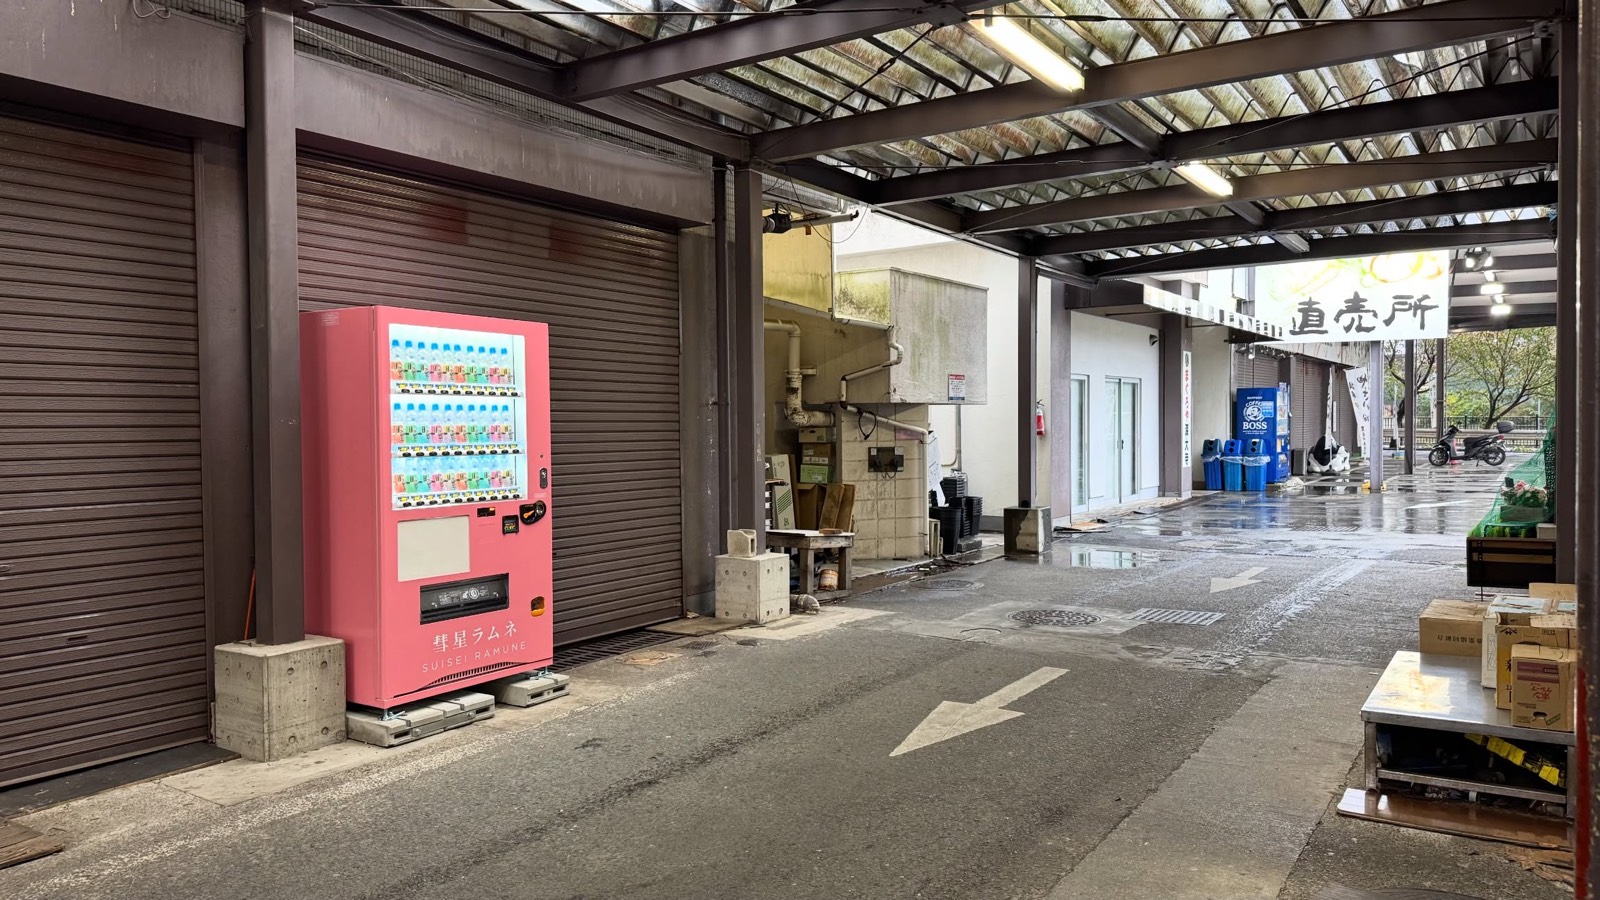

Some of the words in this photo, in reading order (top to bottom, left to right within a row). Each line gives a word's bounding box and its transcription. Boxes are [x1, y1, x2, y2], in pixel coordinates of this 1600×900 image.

[1289, 290, 1439, 335] 直売所
[1242, 421, 1268, 430] BOSS
[433, 620, 517, 653] 彗星ラムネ
[422, 655, 467, 673] SUISEI
[474, 641, 526, 660] RAMUNE
